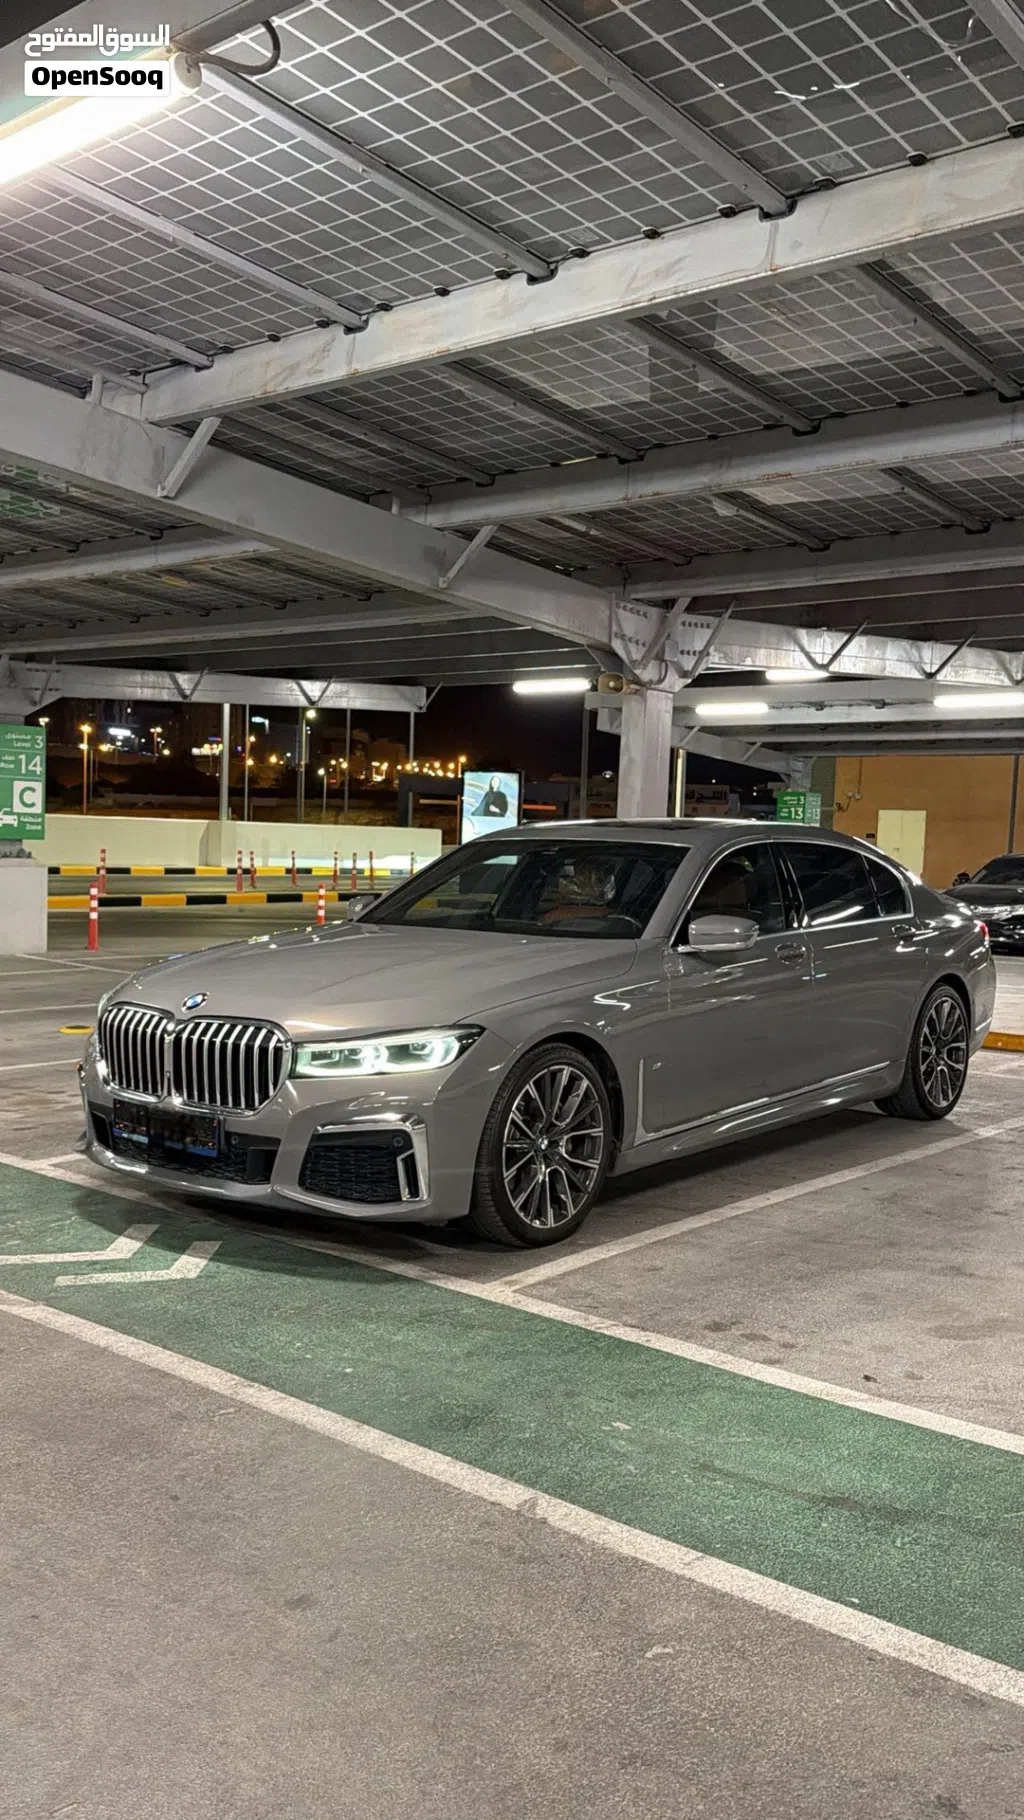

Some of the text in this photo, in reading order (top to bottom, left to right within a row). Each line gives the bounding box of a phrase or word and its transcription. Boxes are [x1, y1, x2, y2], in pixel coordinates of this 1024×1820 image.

[34, 735, 43, 749] 3
[18, 754, 43, 775] 14
[19, 786, 36, 808] C
[790, 807, 803, 819] 13
